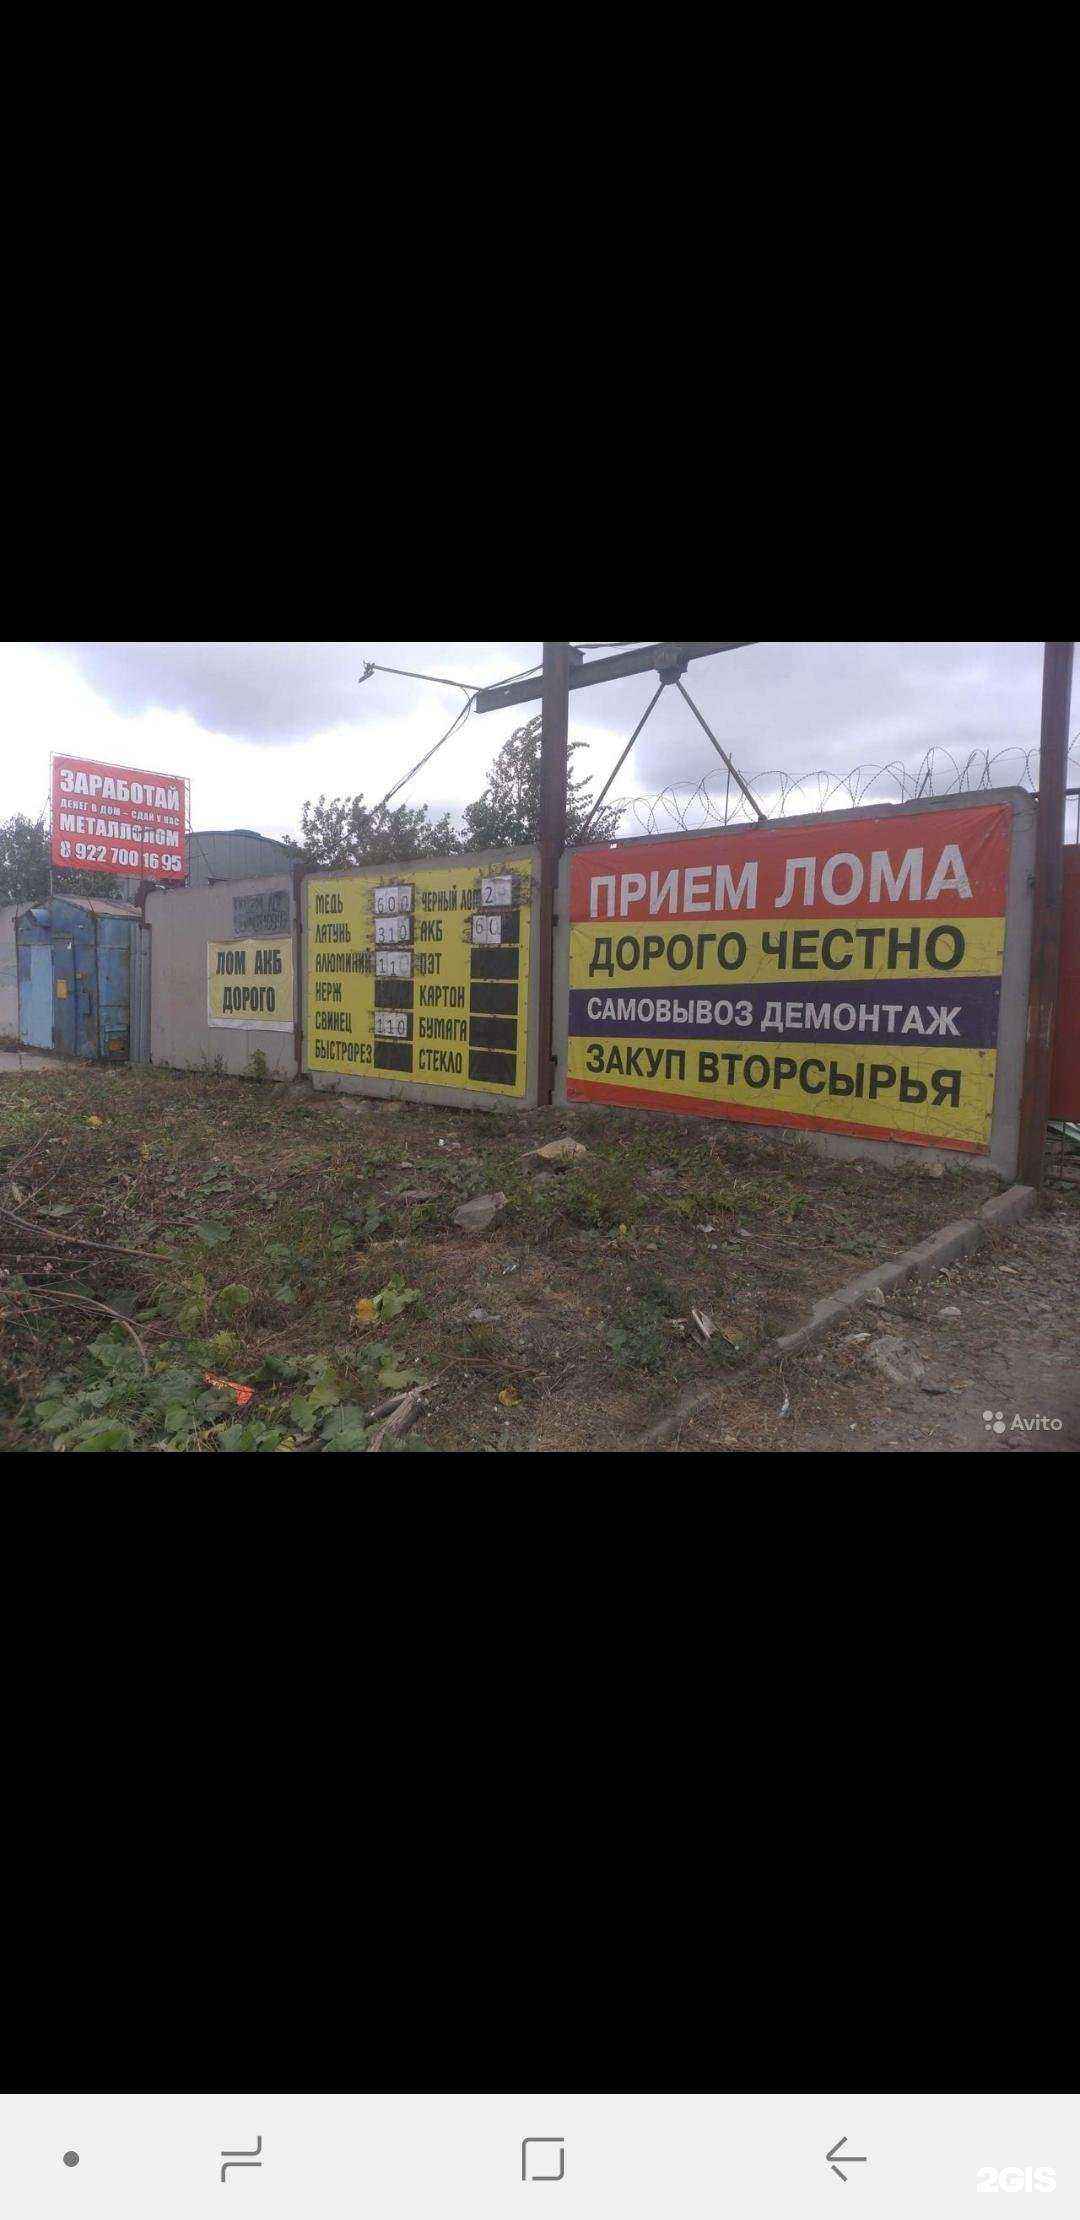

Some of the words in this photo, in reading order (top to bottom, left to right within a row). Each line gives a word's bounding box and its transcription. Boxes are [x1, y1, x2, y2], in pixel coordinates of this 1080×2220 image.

[60, 769, 180, 811] ЗАРАБОТАЙ
[60, 798, 88, 812] ДЕНЕГ
[91, 802, 98, 814] В
[100, 803, 121, 816] ДОМ
[131, 810, 155, 822] СДАЙ
[163, 816, 180, 827] НАС
[60, 813, 179, 848] МЕТАЛЛОЛОМ
[60, 840, 71, 859] 8
[75, 843, 107, 863] 922
[110, 847, 139, 868] 700
[143, 852, 159, 870] 16
[161, 854, 182, 873] 95
[590, 861, 758, 918] ПРИЕМ
[774, 844, 973, 908] ЛОМА
[315, 893, 344, 915] МЕДЬ
[421, 885, 458, 912] ЧЕРНЫЙ
[315, 923, 351, 943] ЛАТУНЬ
[378, 925, 407, 943] 310
[420, 919, 443, 942] АКБ
[216, 950, 246, 975] ЛОМ
[254, 949, 282, 975] АКБ
[588, 932, 747, 978] ДОРОГО
[761, 925, 966, 970] ЧЕСТНО
[222, 986, 276, 1014] ДОРОГО
[315, 981, 342, 1003] НЕРЖ
[419, 984, 465, 1008] КАРТОН
[315, 1010, 352, 1034] СВИНЕЦ
[377, 1018, 405, 1035] 110
[419, 1016, 467, 1042] БУМАГА
[587, 997, 753, 1026] САМОВЫВОЗ
[760, 1001, 962, 1036] ДЕМОНТАЖ
[315, 1039, 372, 1064] БЫСТРОРЕЗ
[418, 1047, 462, 1074] СТЕКЛО
[586, 1043, 686, 1080] ЗАКУП
[698, 1051, 961, 1108] ВТОРСЫРЬЯ
